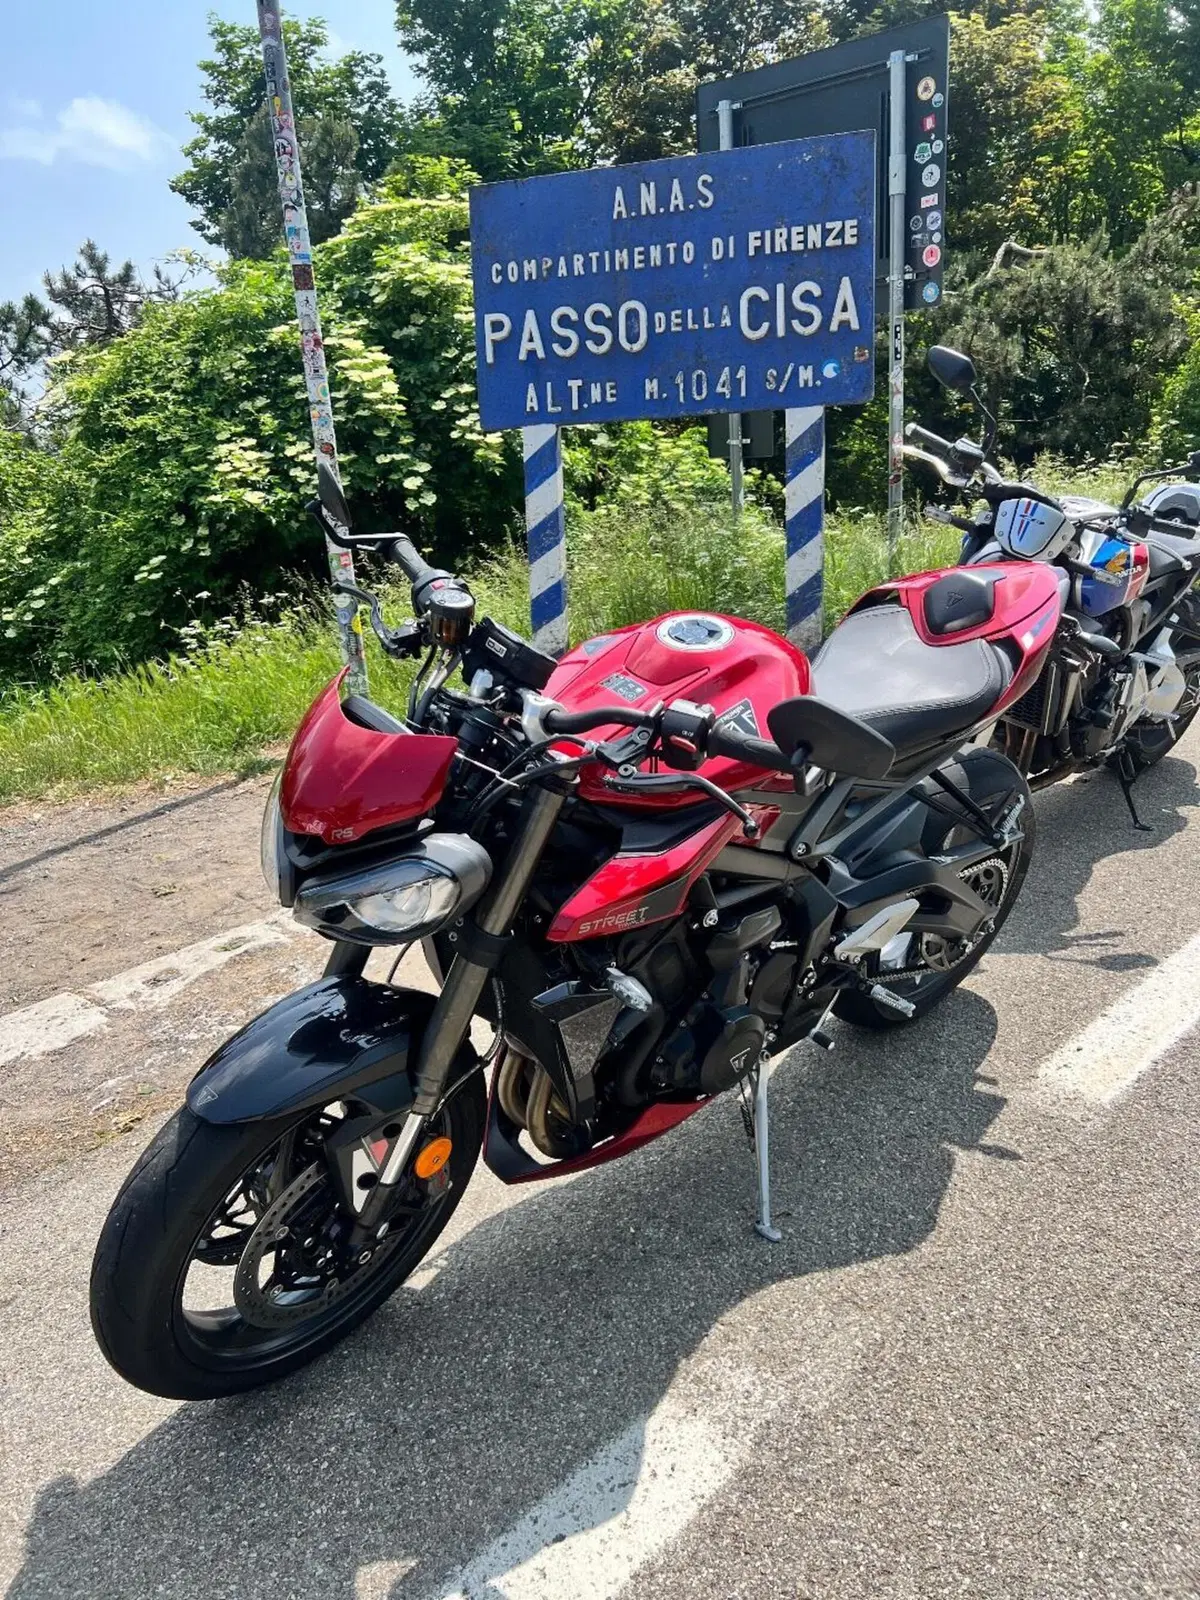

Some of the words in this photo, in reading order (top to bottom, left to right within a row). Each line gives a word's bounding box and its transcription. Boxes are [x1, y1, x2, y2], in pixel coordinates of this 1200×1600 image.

[612, 174, 715, 220] A.N.A.S
[491, 240, 695, 284] COMPARTIMENTO
[712, 235, 735, 261] DI
[748, 219, 859, 257] FIRENZE
[484, 299, 649, 364] PASSO
[654, 305, 732, 334] DELLA
[739, 276, 860, 342] CISA
[674, 365, 747, 404] 1041
[331, 827, 354, 840] RS
[579, 906, 649, 934] STREET
